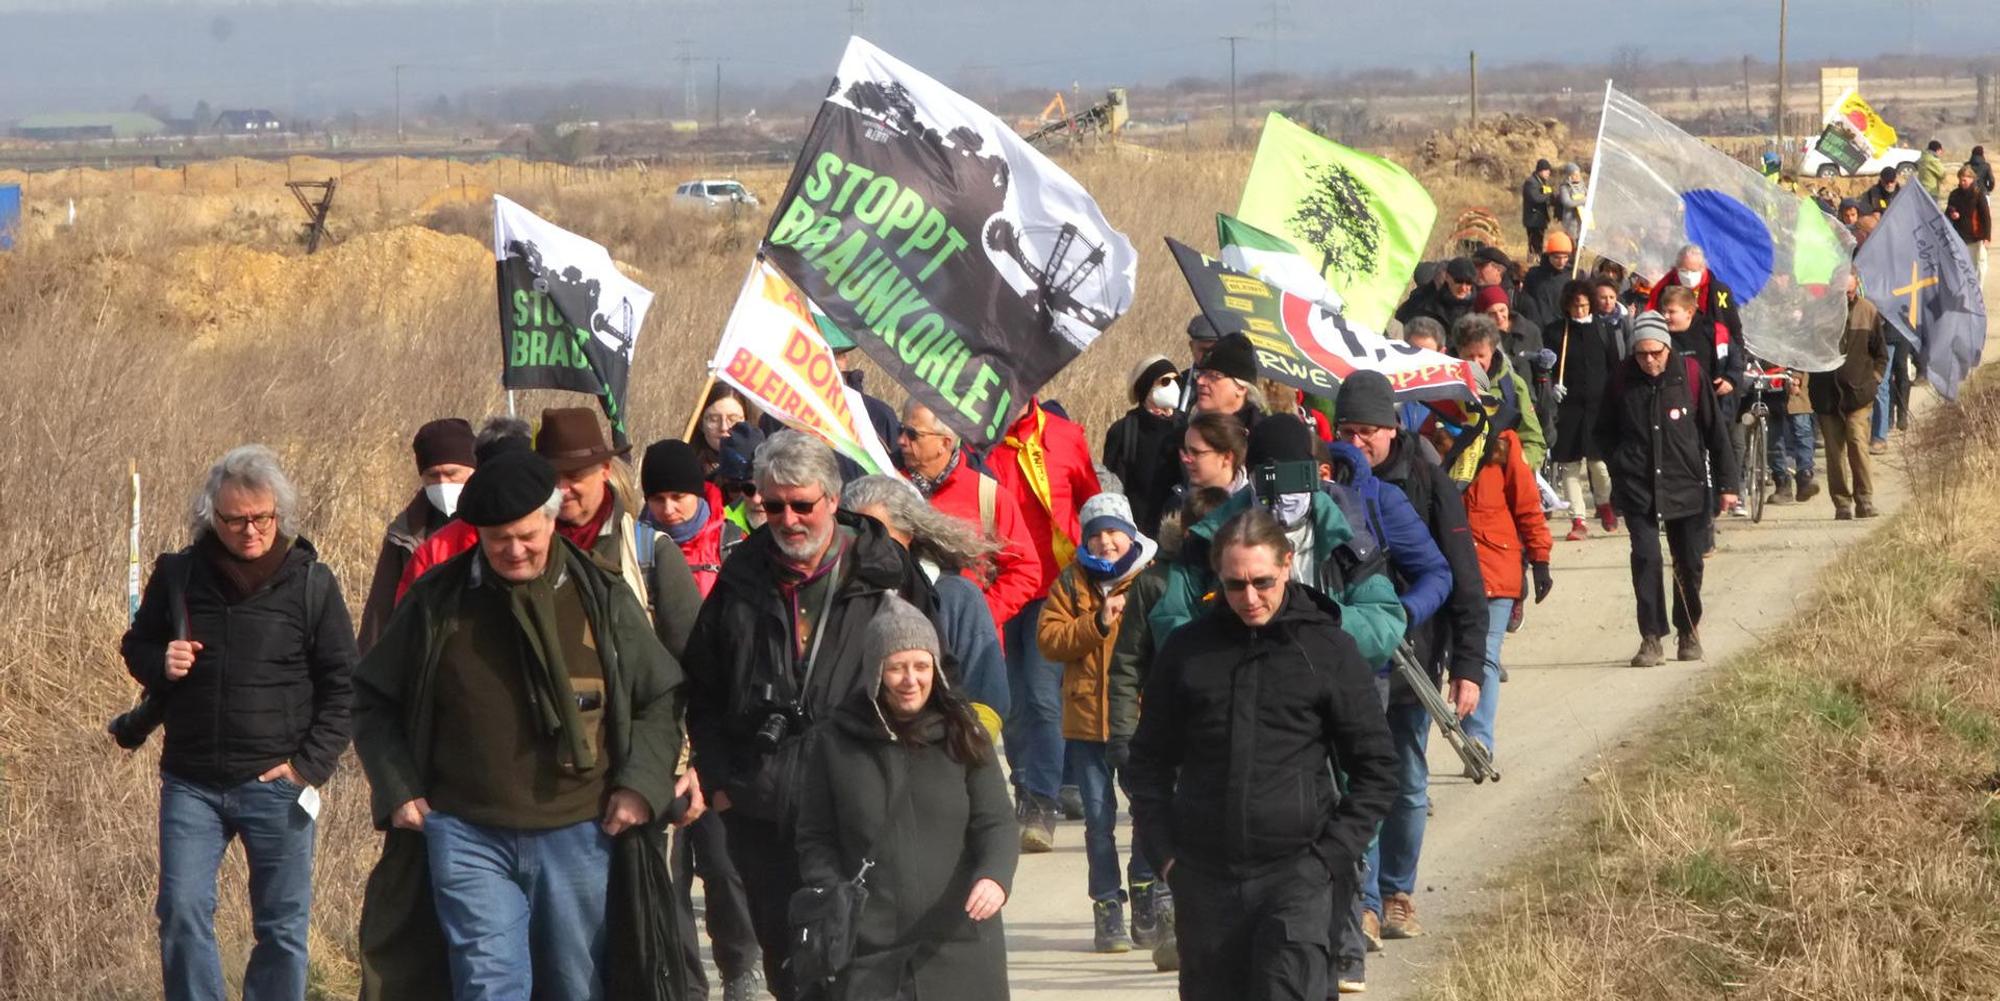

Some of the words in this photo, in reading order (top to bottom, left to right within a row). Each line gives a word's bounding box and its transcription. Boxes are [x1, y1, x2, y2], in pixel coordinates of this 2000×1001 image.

[805, 151, 969, 282] STOPPT
[511, 330, 592, 369] BRAU
[769, 196, 1011, 440] BRAUNKOHLE!
[1257, 350, 1332, 388] RWE
